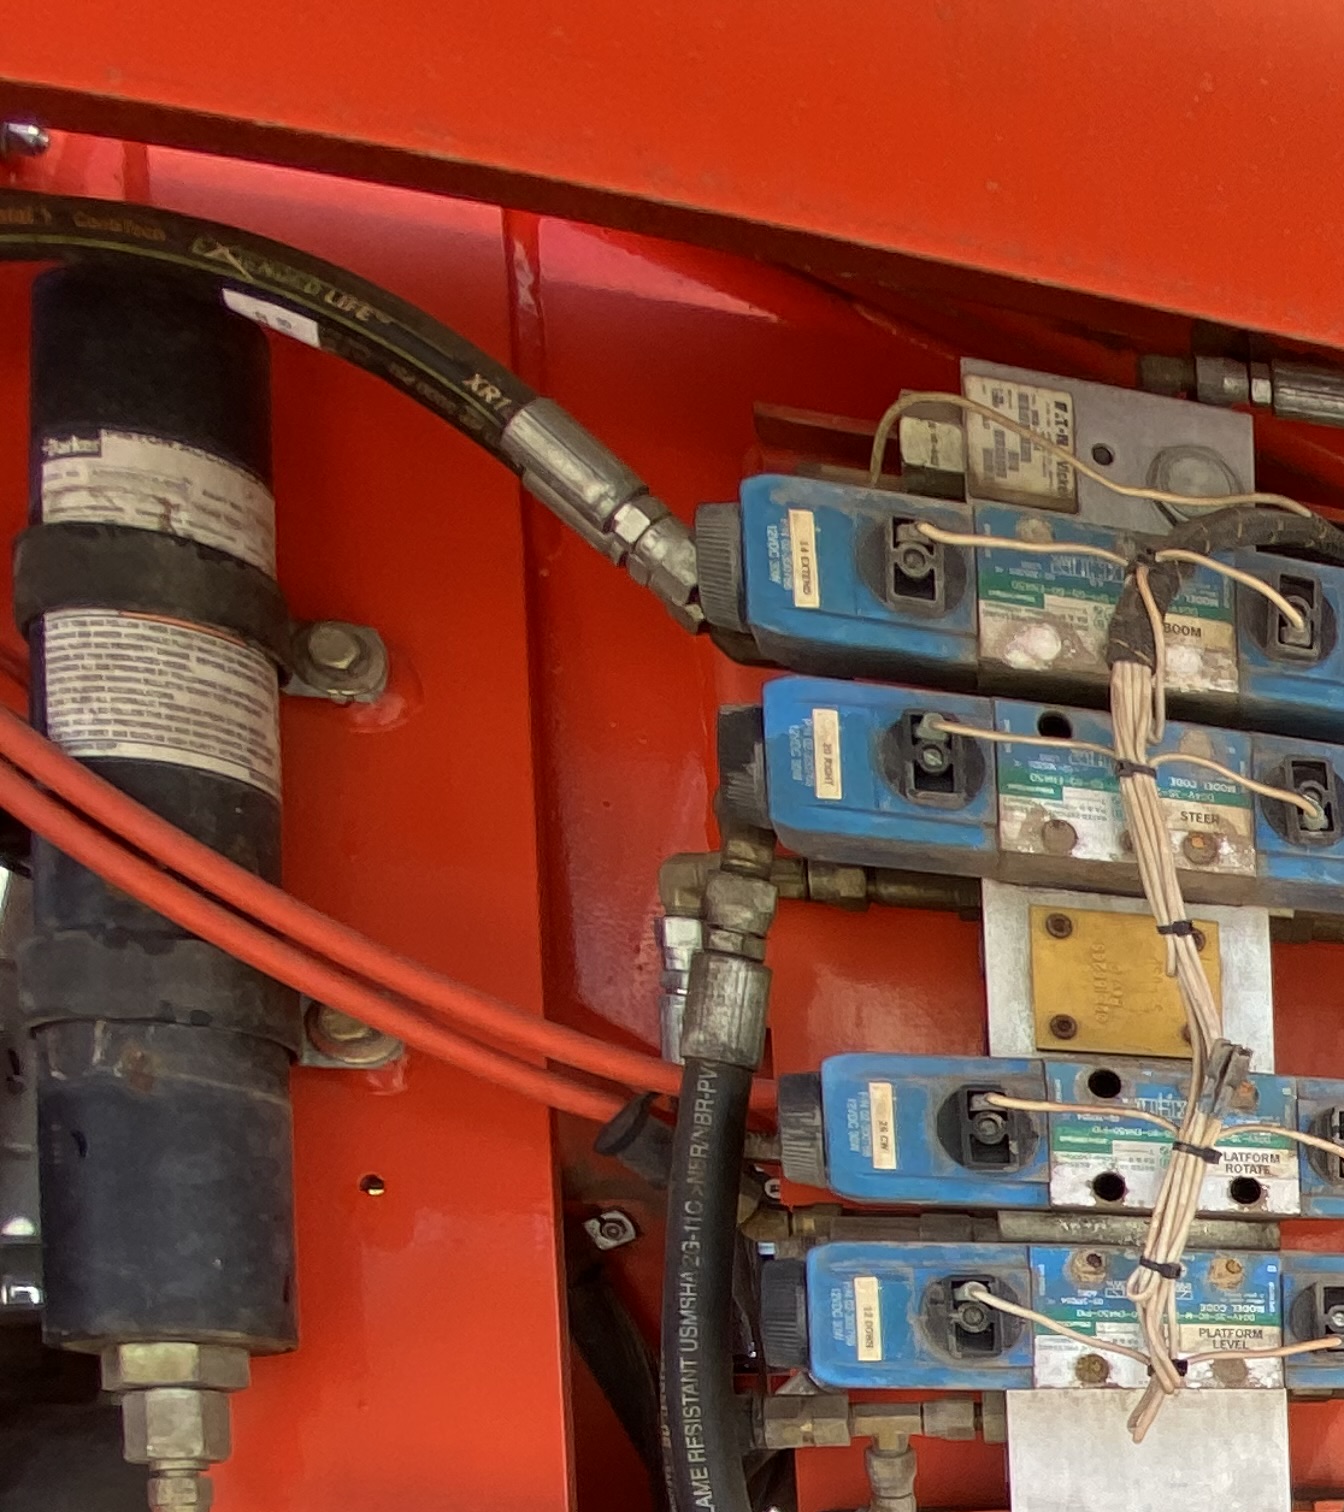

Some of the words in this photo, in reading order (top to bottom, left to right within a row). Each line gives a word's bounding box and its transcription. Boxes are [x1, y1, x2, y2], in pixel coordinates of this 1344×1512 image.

[1163, 622, 1202, 637] BOOM
[1222, 1151, 1281, 1164] LATFORM
[1225, 1163, 1271, 1175] ROTATE
[1199, 1327, 1264, 1339] PLATFORM
[1212, 1339, 1249, 1350] LEVEL
[679, 1357, 705, 1463] RESISTANT
